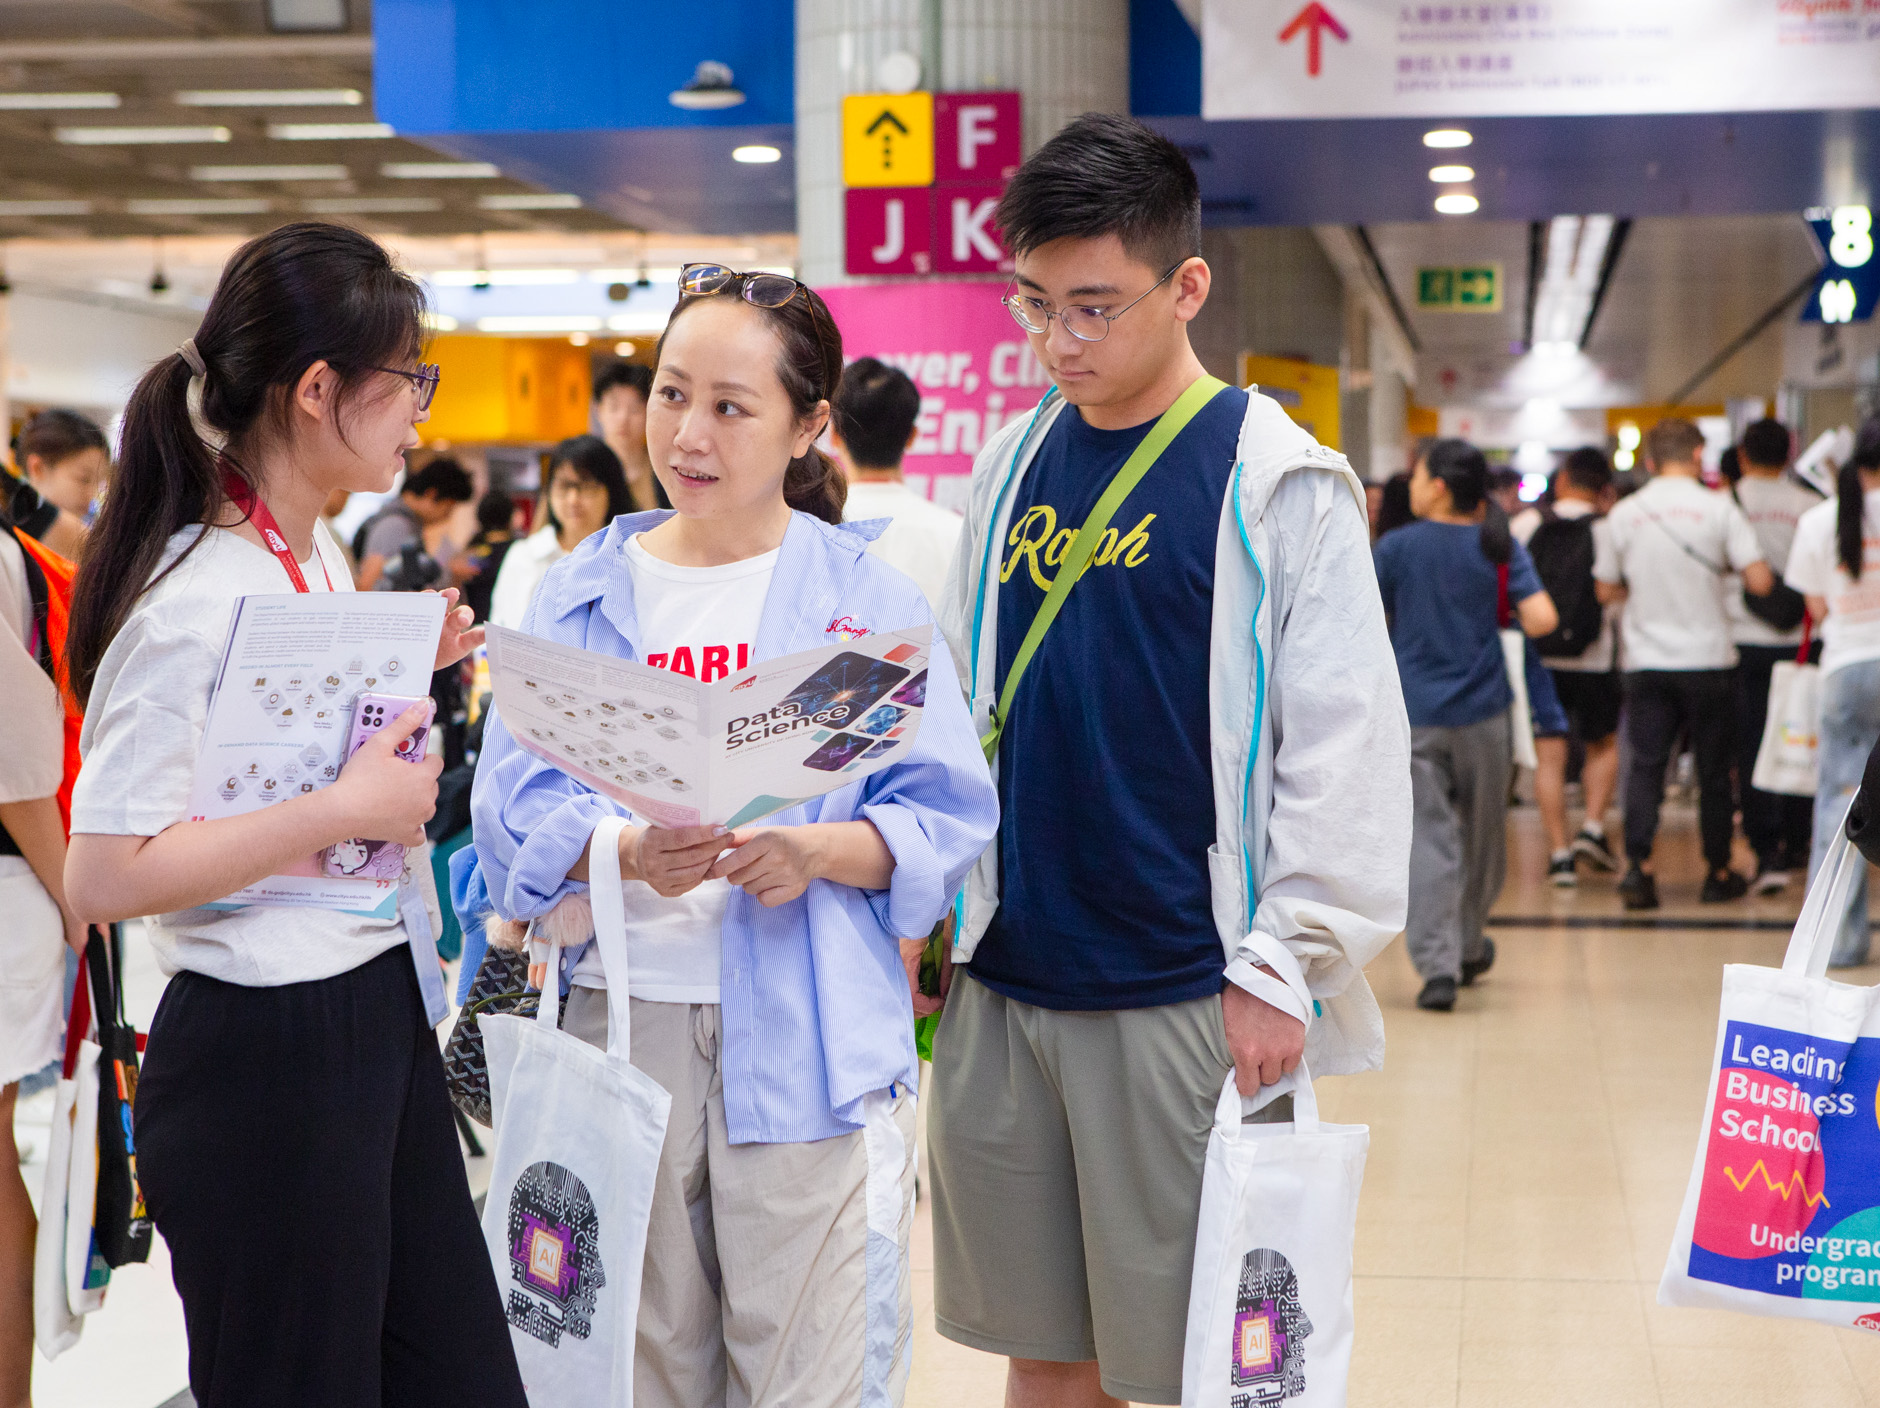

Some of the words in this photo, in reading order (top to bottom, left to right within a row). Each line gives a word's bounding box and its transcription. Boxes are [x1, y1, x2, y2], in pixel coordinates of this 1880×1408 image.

[957, 105, 997, 169] F
[872, 199, 905, 263] J
[952, 198, 1001, 262] K
[1829, 204, 1874, 268] 8
[1000, 505, 1157, 592] Raph
[725, 706, 848, 751] Science
[727, 703, 800, 735] Data
[1726, 1071, 1857, 1117] Business
[1719, 1109, 1821, 1154] School
[538, 1248, 555, 1268] AI
[1249, 1333, 1263, 1351] AI
